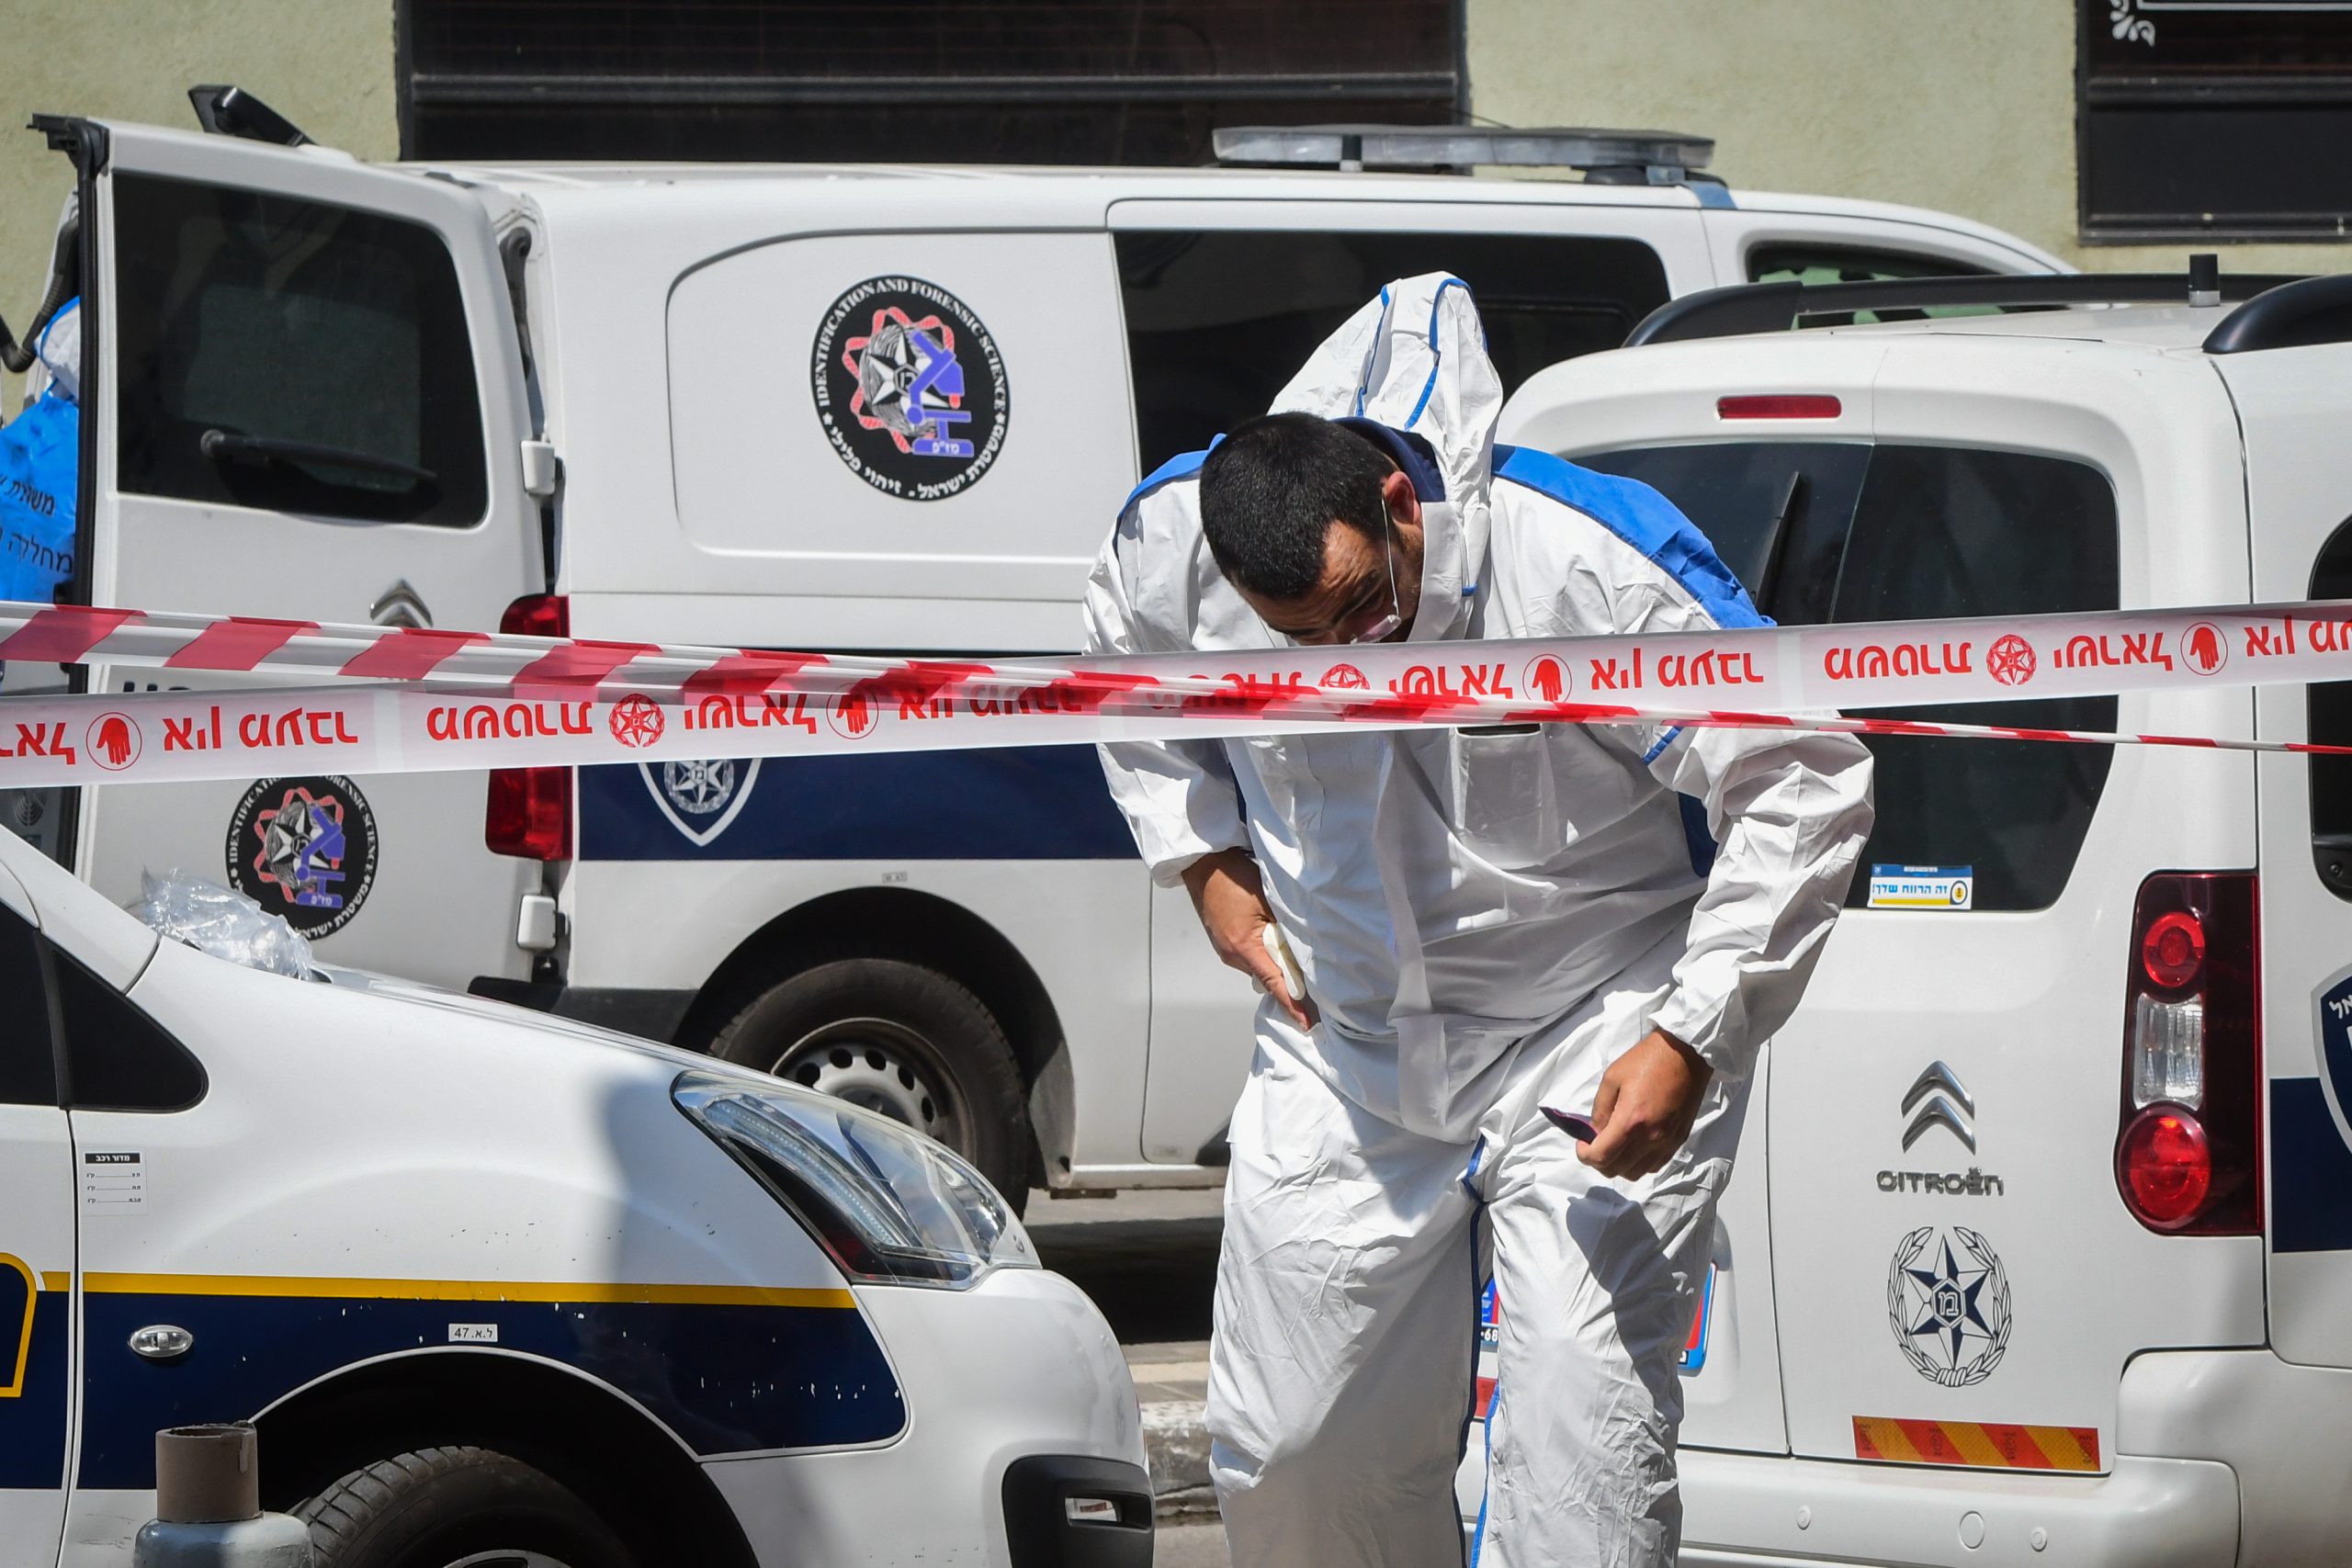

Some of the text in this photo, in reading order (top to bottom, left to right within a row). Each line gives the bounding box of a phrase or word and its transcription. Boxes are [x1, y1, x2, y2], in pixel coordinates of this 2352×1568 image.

[815, 278, 1007, 412] IDENTIFICATION AND FORENSIC SCIENCE
[163, 705, 222, 751] אין
[239, 707, 359, 746] מעבר
[426, 702, 594, 741] משטרת
[1590, 647, 1643, 690] אין
[1657, 649, 1765, 688] מעבר
[1824, 641, 1973, 681] משטרת
[2052, 631, 2174, 672] ישראל
[2245, 615, 2296, 658] אין
[324, 775, 368, 813] ORENSIC
